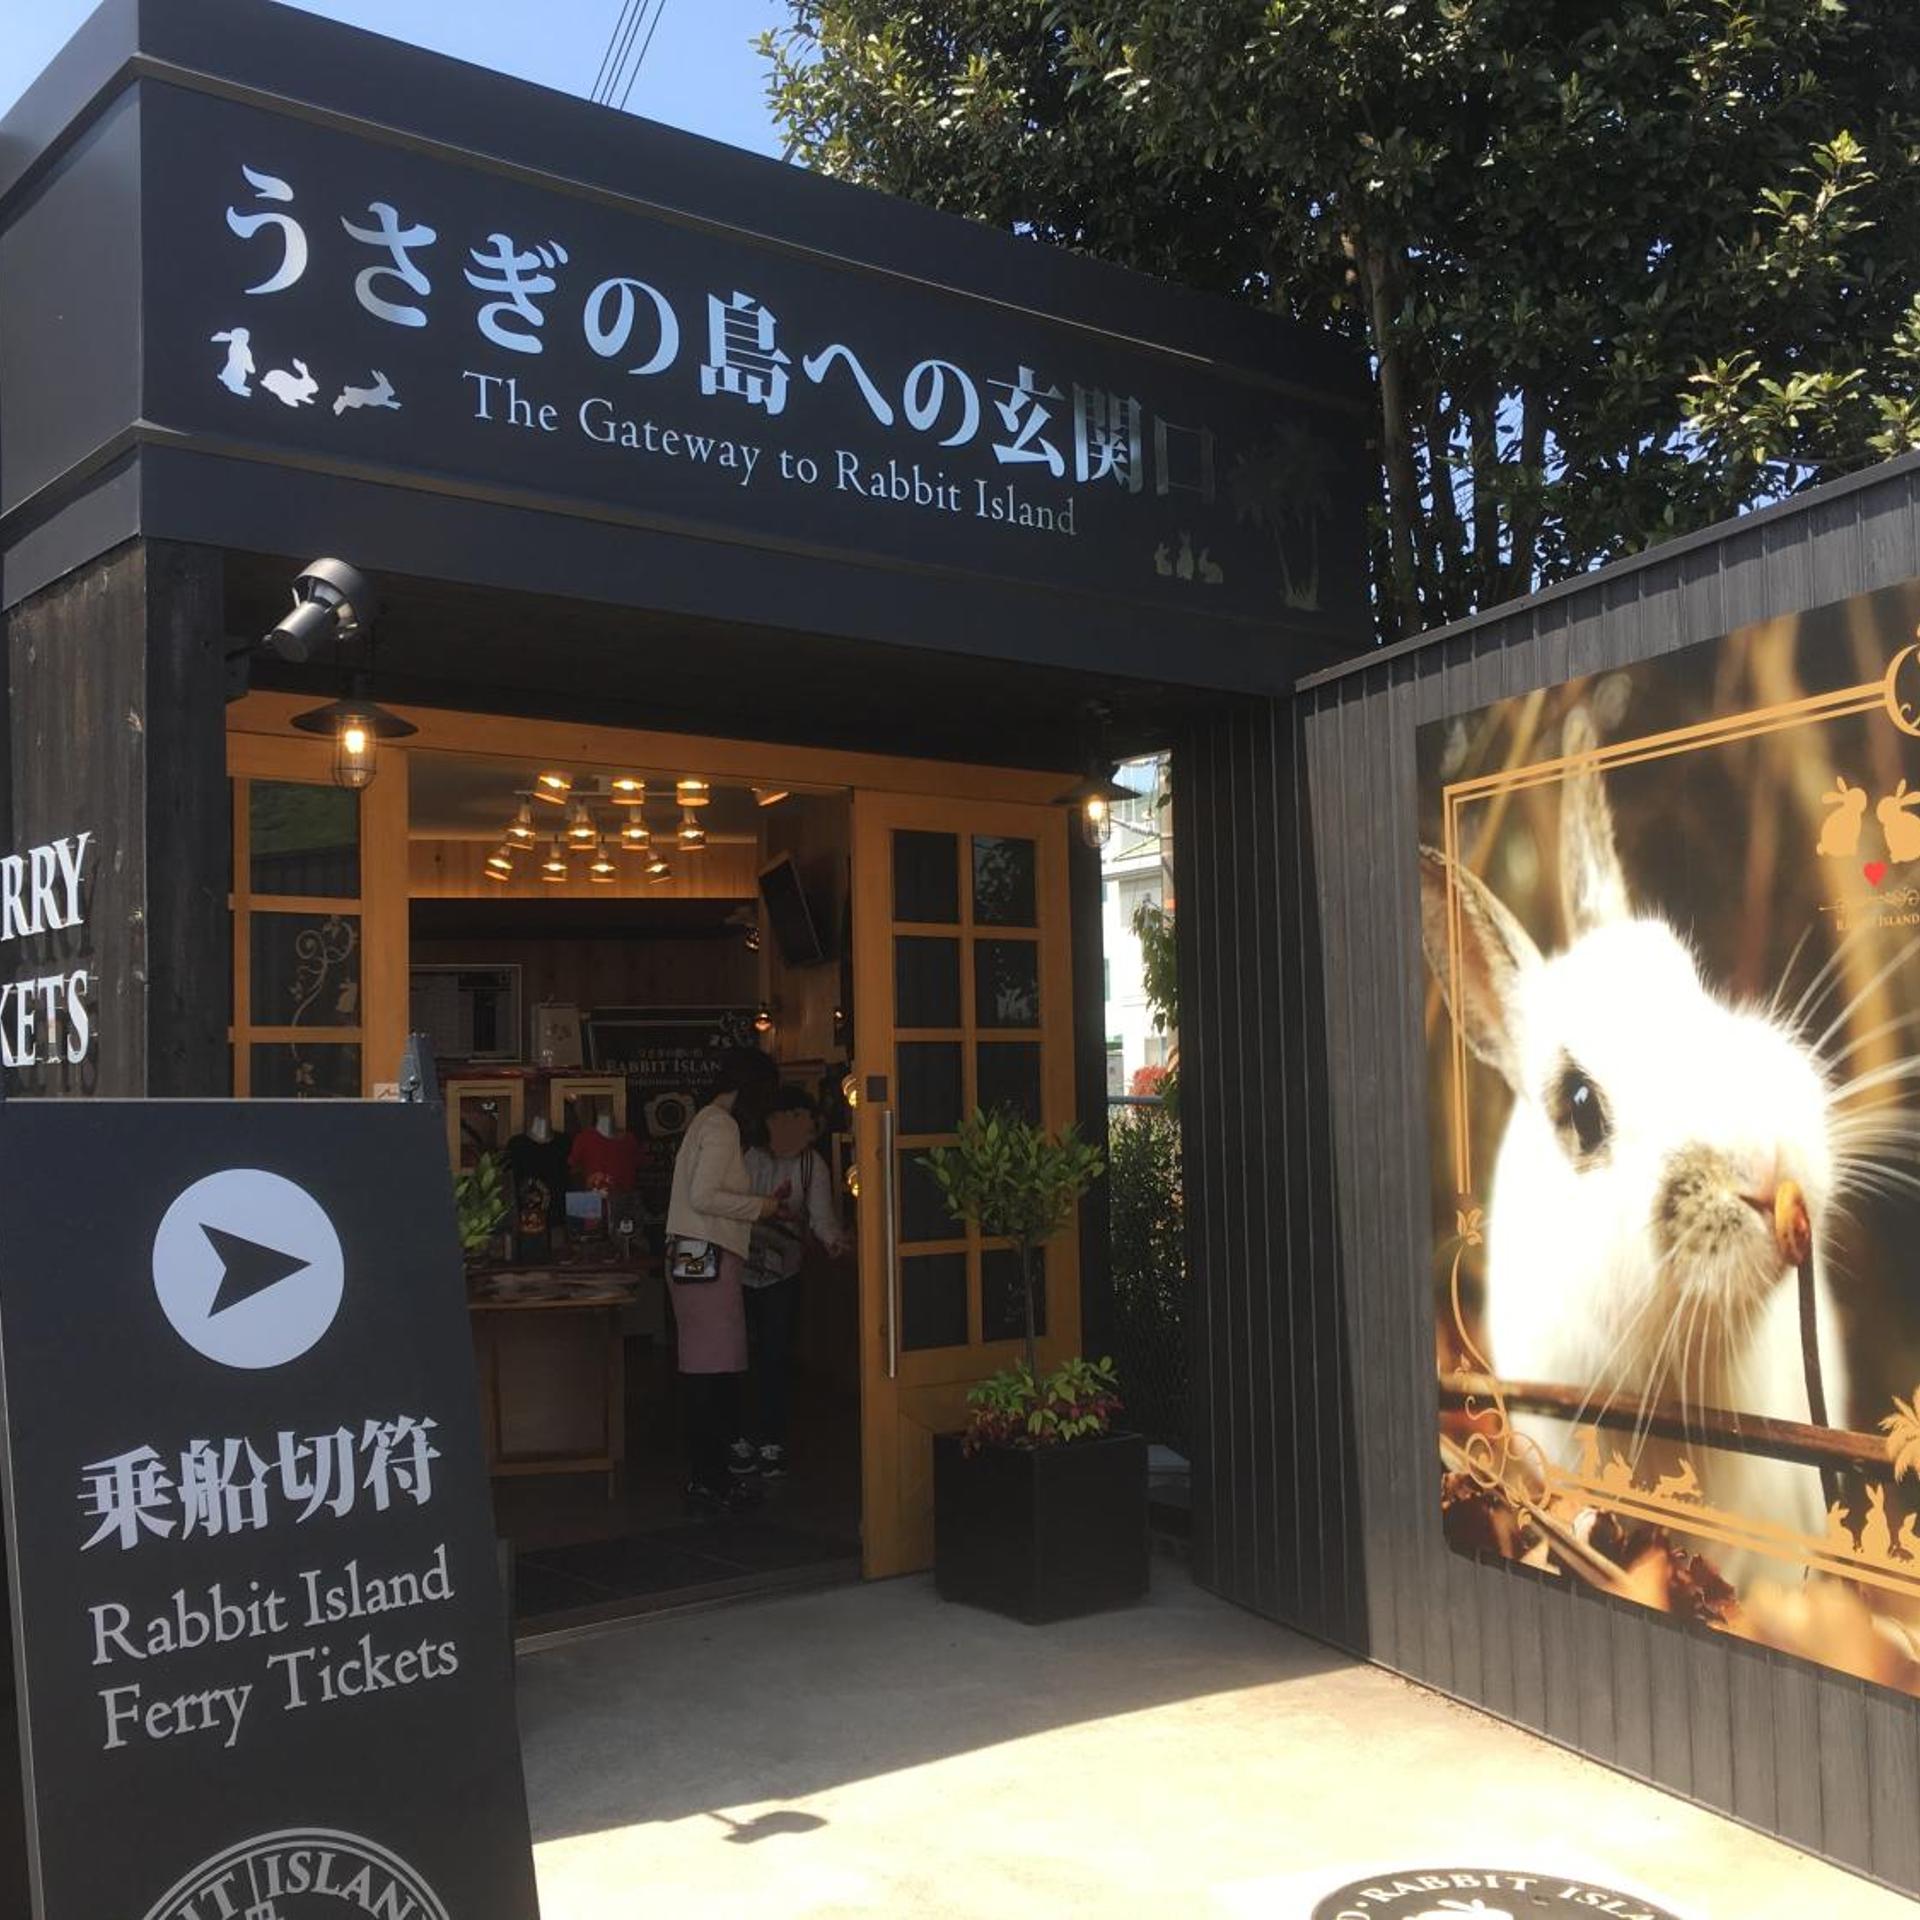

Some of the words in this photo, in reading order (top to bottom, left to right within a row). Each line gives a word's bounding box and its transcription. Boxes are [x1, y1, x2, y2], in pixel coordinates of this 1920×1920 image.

[226, 164, 1216, 503] うさぎの島への玄関口
[462, 370, 558, 431] The
[579, 398, 760, 486] Gateway
[779, 450, 818, 484] to
[835, 450, 961, 512] Rabbit
[974, 479, 1077, 536] Island
[77, 1415, 441, 1551] 乗船切符
[88, 1580, 288, 1665] Rabbit
[300, 1543, 456, 1628] Island
[99, 1683, 253, 1750] Ferry
[267, 1633, 459, 1711] Tickets
[1358, 1874, 1538, 1902] RABBIT
